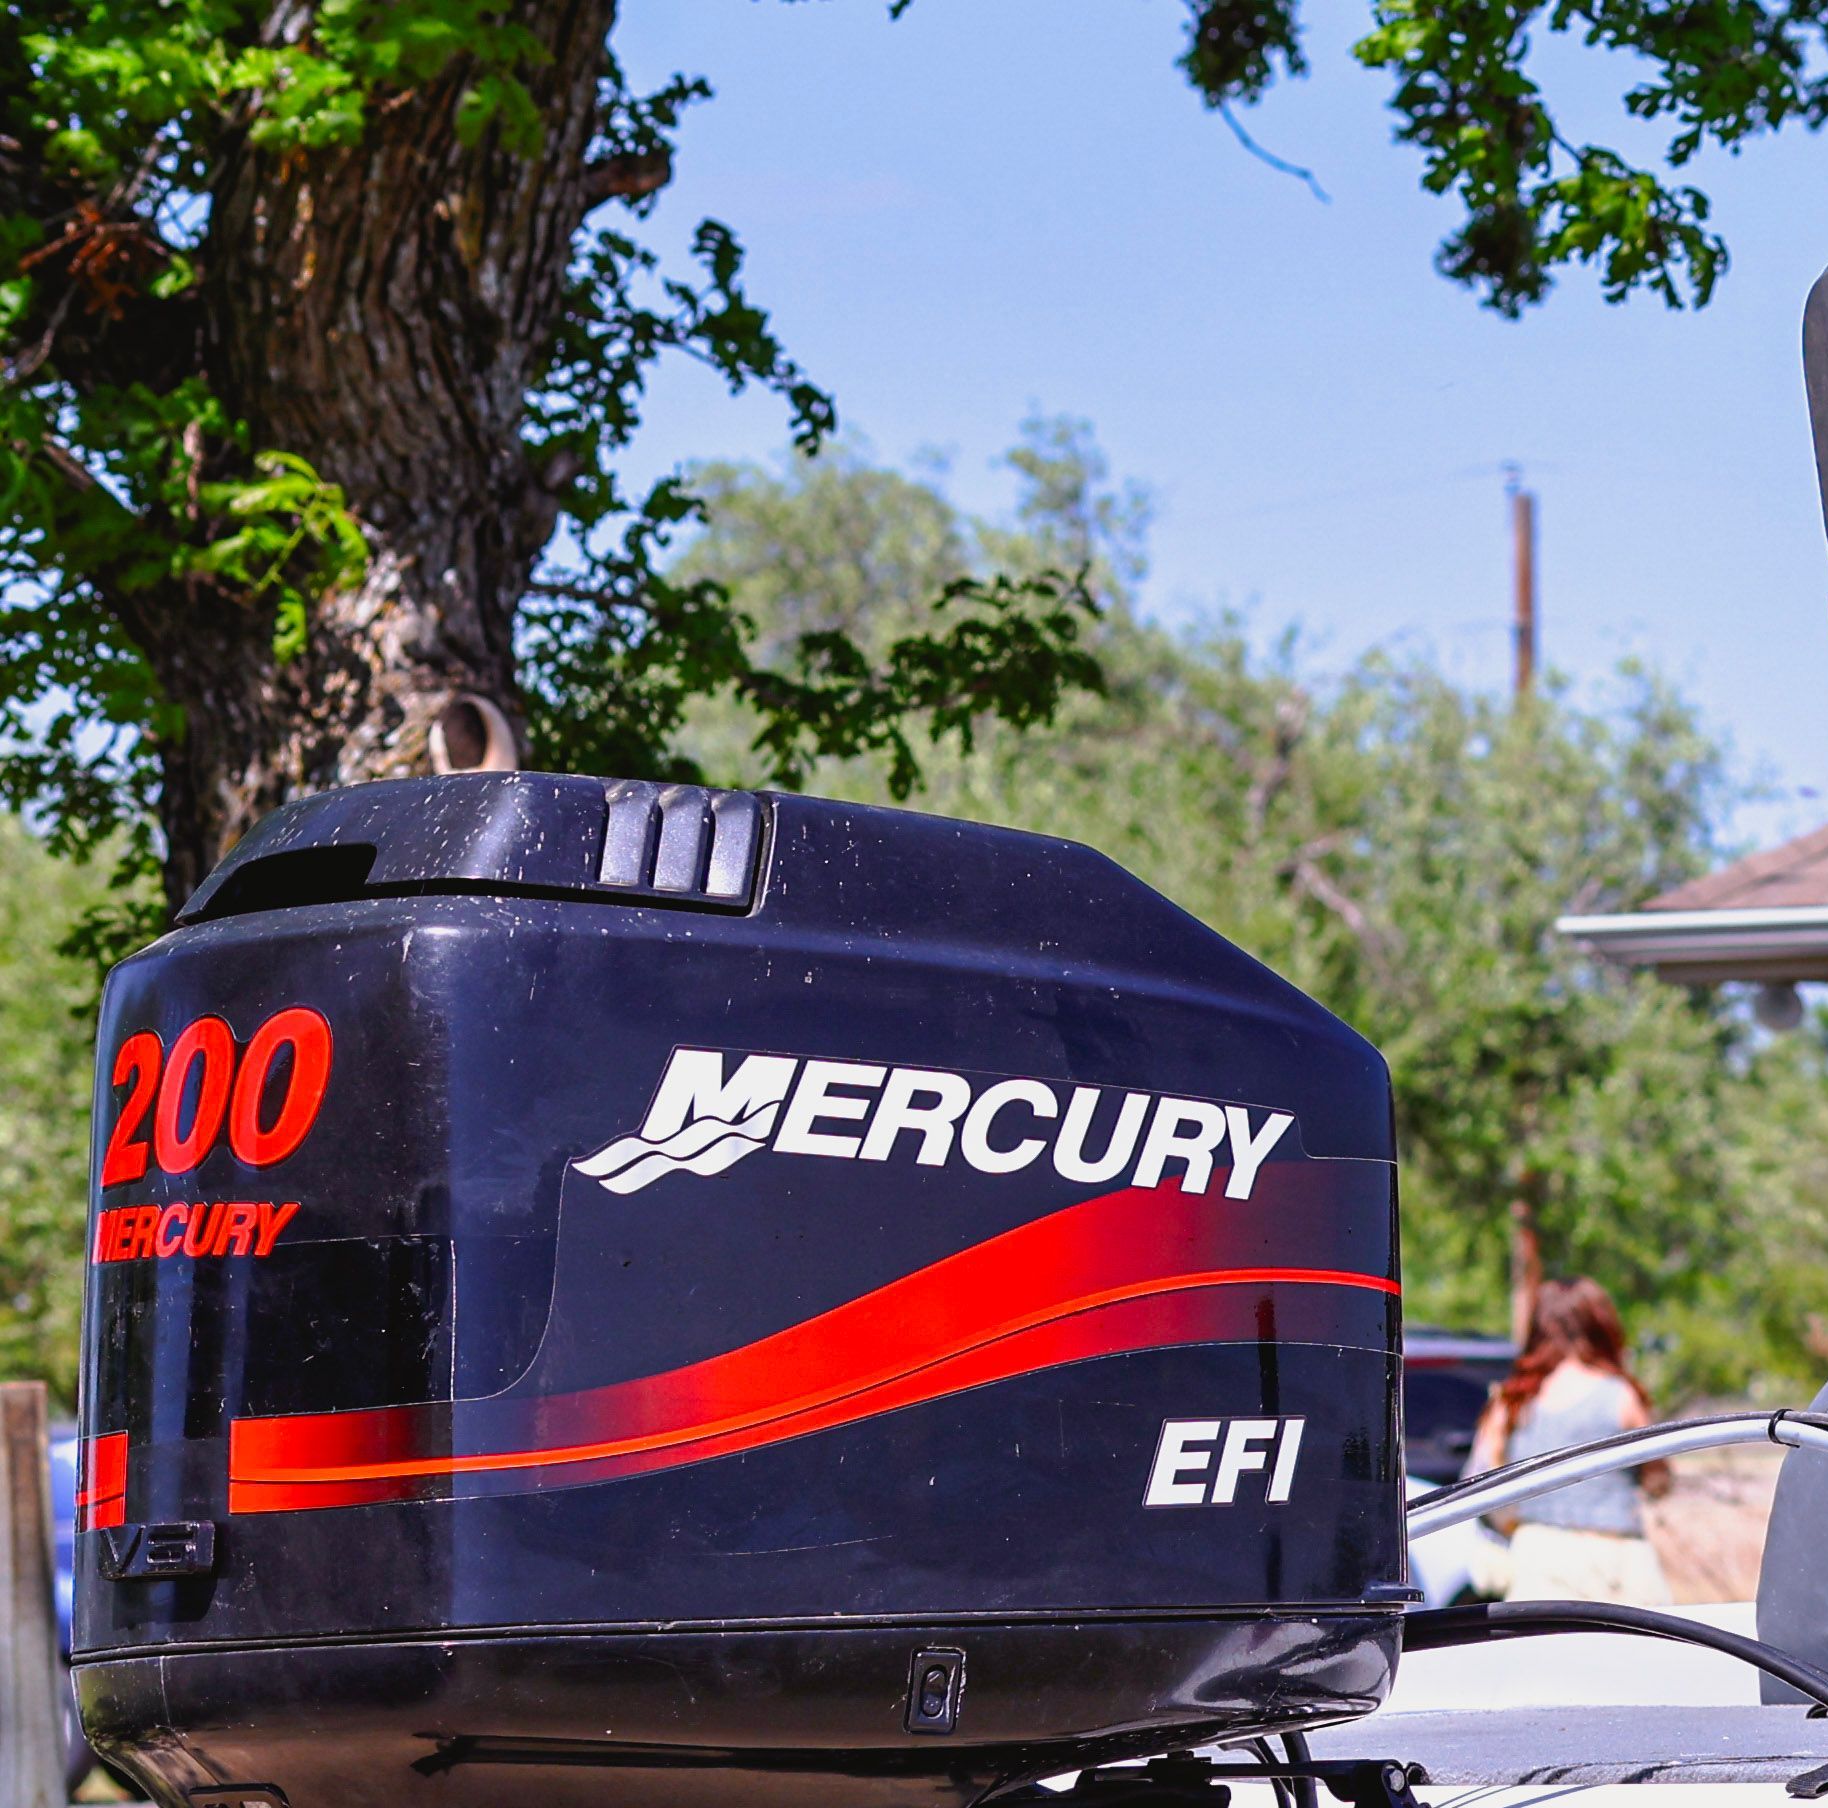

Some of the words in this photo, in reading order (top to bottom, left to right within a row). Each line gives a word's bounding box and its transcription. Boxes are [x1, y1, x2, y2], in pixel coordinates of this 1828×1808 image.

[101, 1006, 334, 1188] 200
[572, 1046, 1296, 1199] MERCURY
[91, 1200, 302, 1265] MERCURY
[1144, 1415, 1306, 1508] EFI
